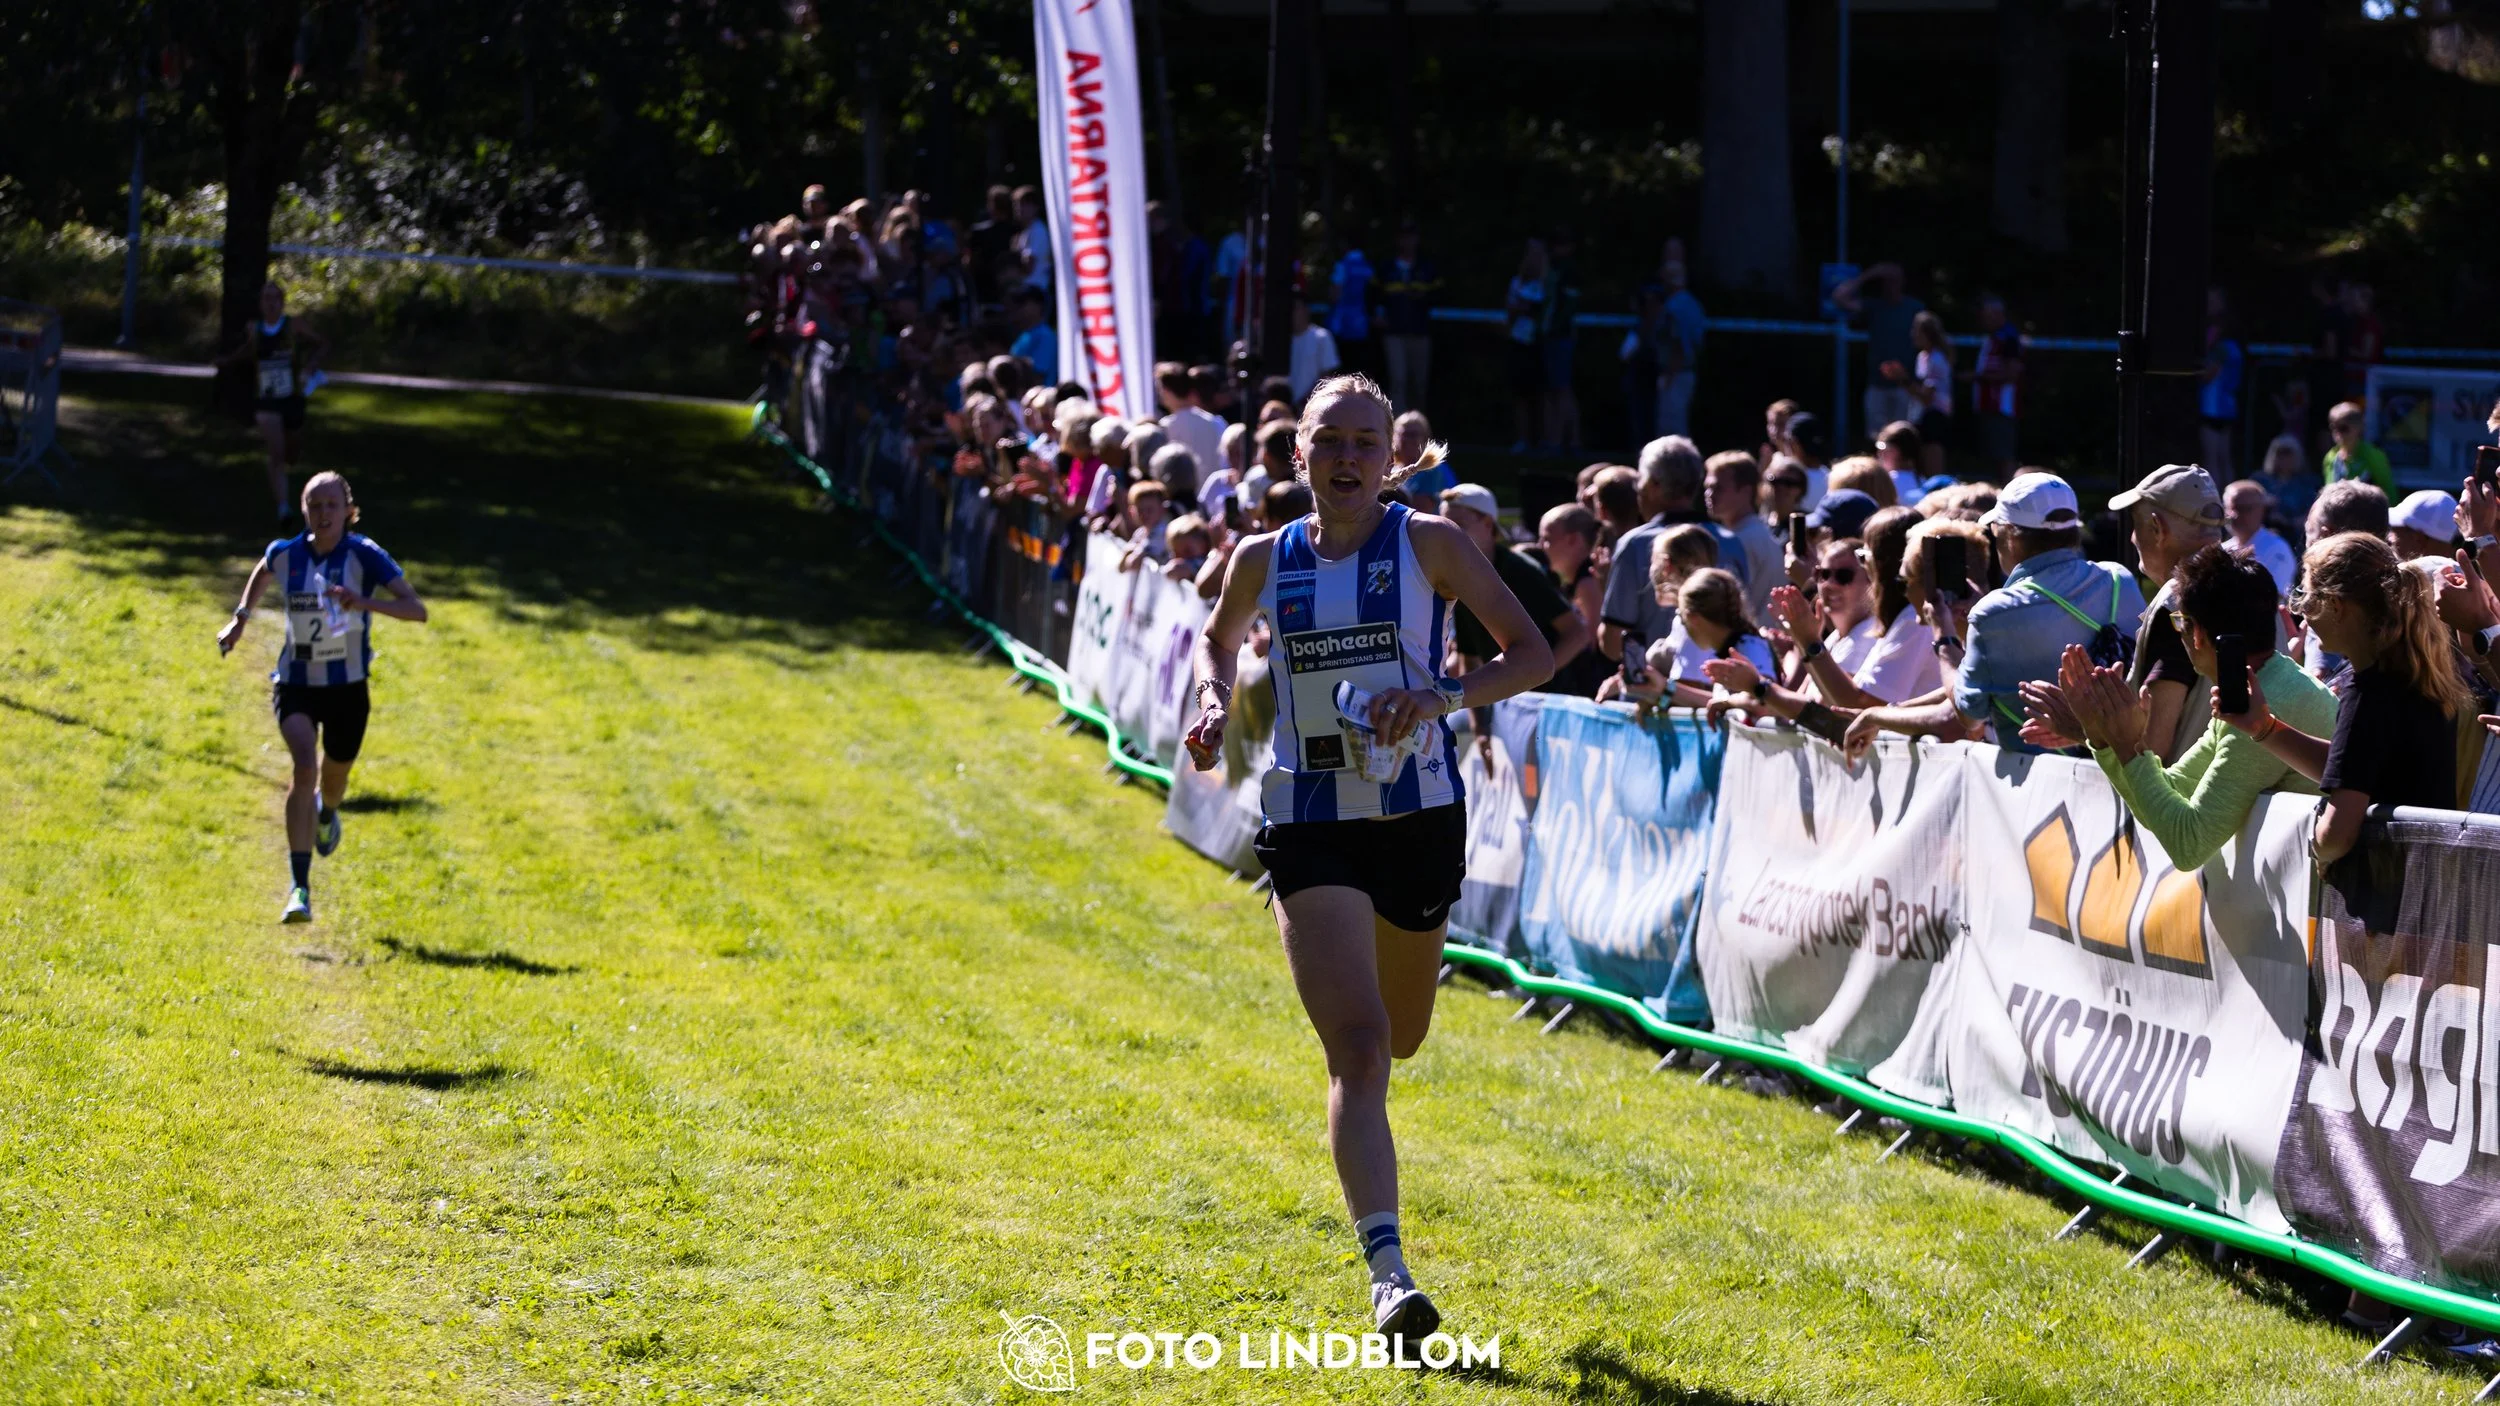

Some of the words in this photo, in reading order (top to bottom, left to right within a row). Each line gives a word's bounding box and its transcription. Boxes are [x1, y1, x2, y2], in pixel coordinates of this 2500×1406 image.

[309, 617, 323, 642] 2
[1291, 631, 1392, 657] bagheera
[1318, 654, 1374, 669] SPRINTDISTANS
[1375, 652, 1392, 661] 2025
[1872, 877, 1950, 963] Bank
